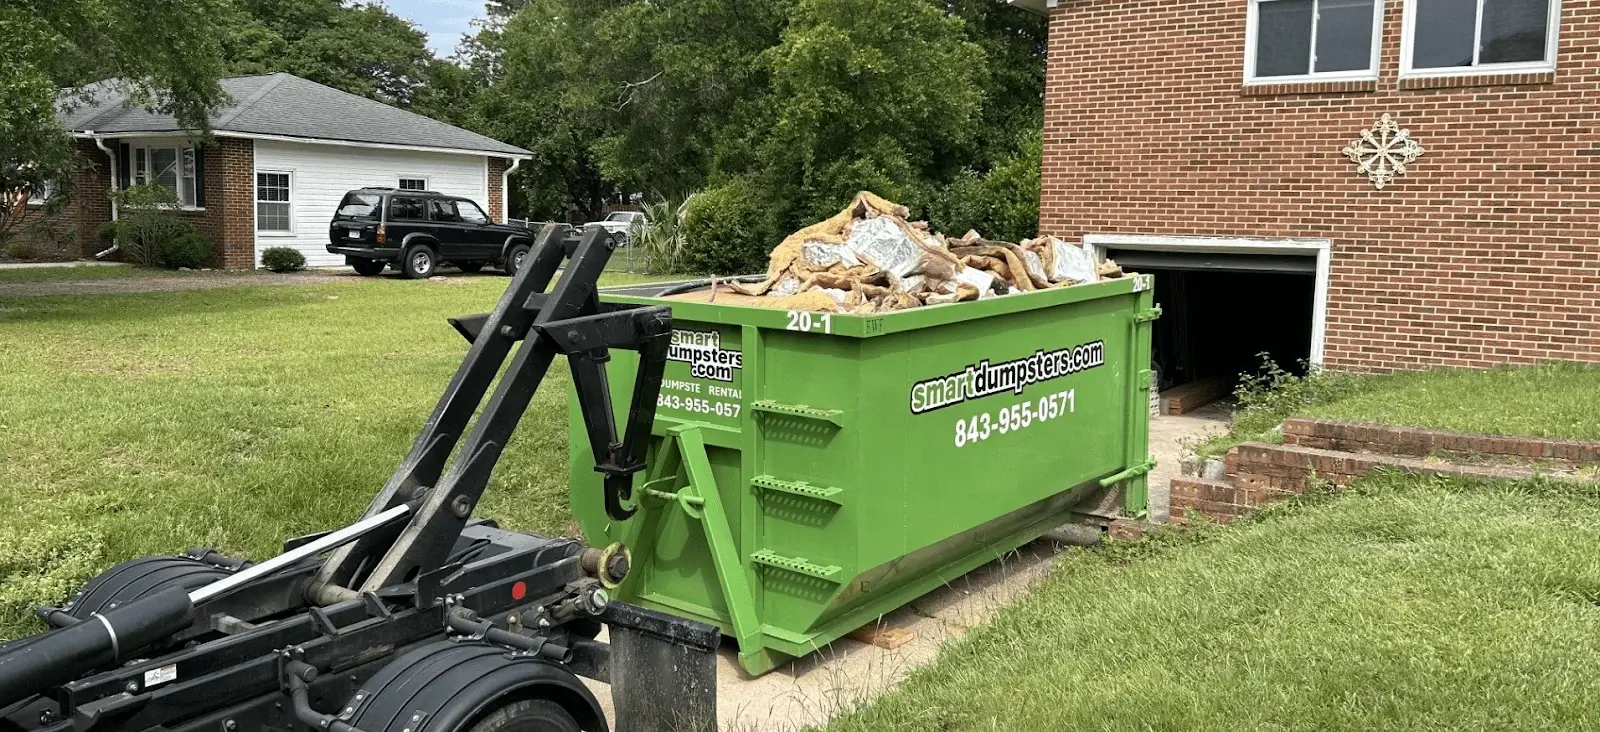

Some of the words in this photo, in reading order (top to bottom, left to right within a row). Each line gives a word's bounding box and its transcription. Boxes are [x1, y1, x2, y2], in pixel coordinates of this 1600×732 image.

[1132, 275, 1150, 293] 20-1
[786, 310, 831, 334] 20-1
[670, 329, 719, 348] smart
[667, 344, 742, 367] umpsters
[692, 363, 732, 380] .com
[912, 341, 1103, 412] smartdumpsters.com
[954, 388, 1075, 448] 843-955-0571
